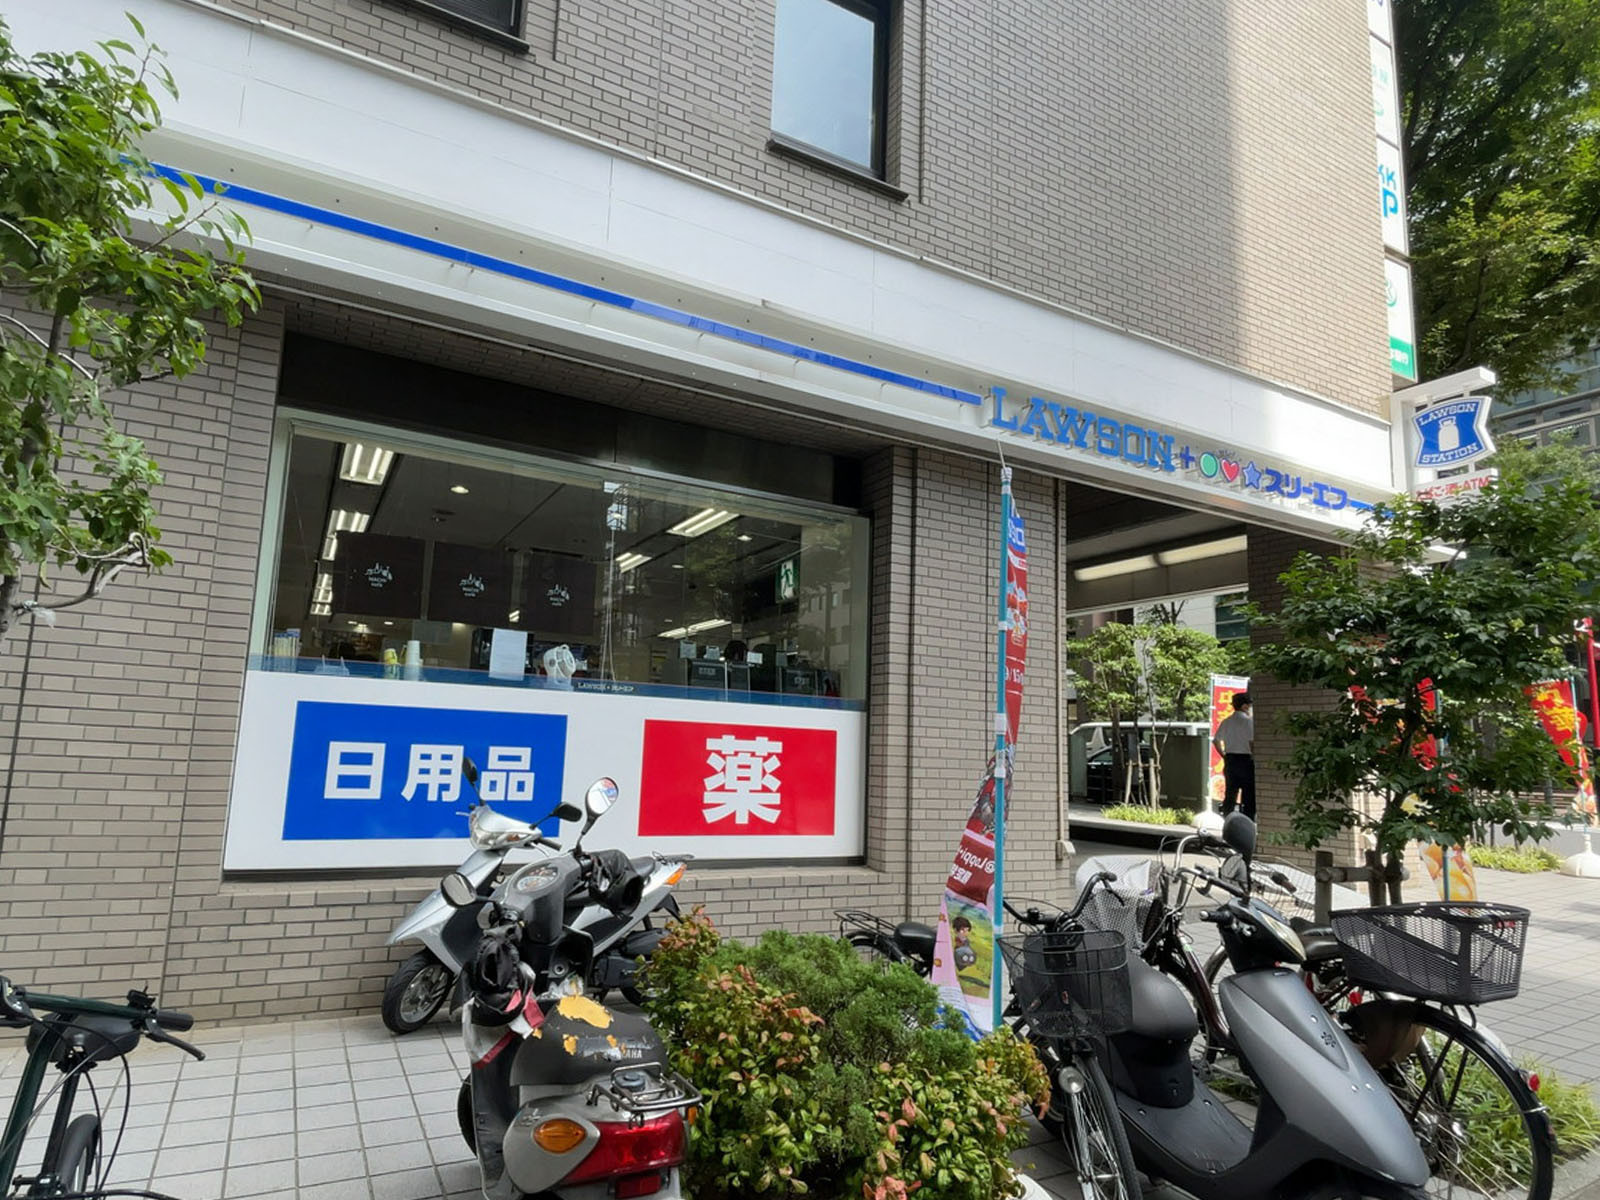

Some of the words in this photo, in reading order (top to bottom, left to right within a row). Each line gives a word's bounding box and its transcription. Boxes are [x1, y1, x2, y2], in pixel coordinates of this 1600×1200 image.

[991, 385, 1176, 472] LAWSON
[1418, 402, 1478, 426] LAWSON
[1420, 442, 1480, 463] STATION
[1264, 467, 1349, 510] スリーエフ
[323, 741, 536, 803] 日用品
[702, 734, 783, 825] 薬
